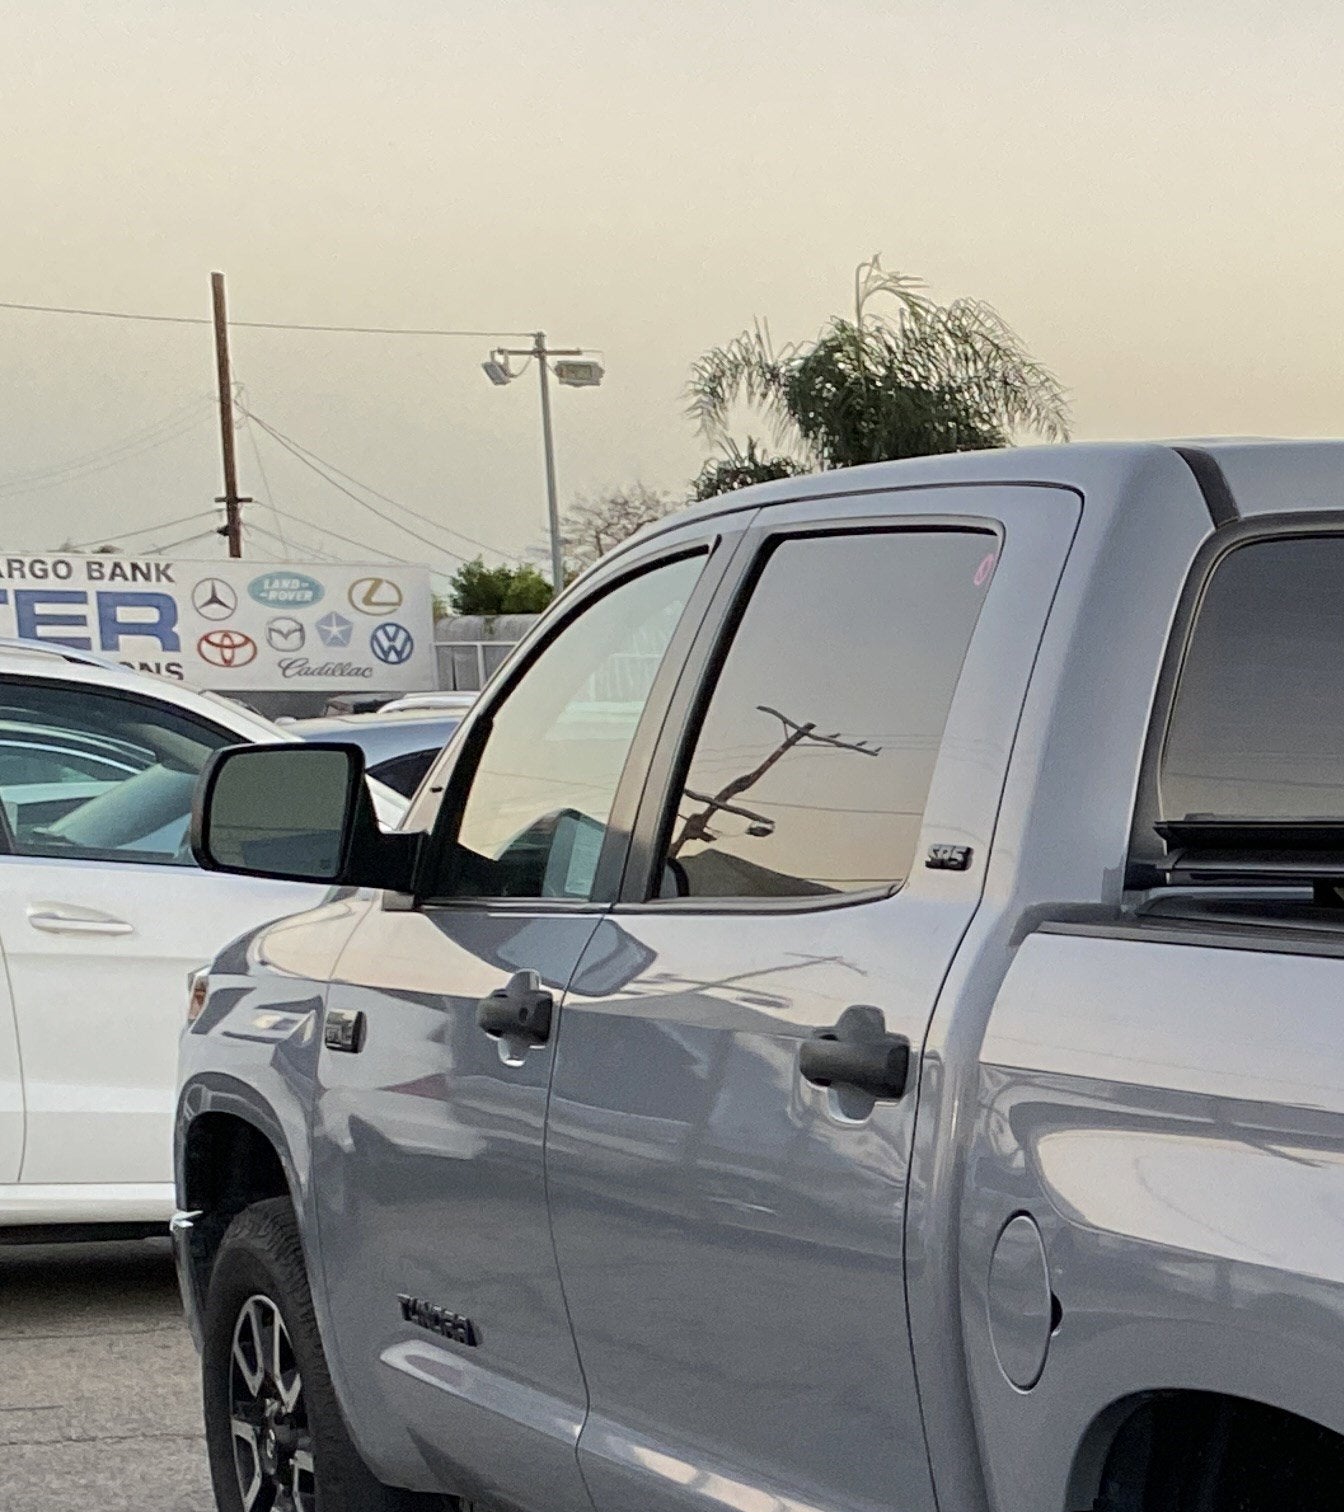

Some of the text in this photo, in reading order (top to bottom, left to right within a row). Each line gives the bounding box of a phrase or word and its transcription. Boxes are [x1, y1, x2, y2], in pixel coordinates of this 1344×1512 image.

[0, 558, 175, 583] RGO BANK
[0, 589, 181, 652] ER
[277, 657, 374, 679] Cadillac
